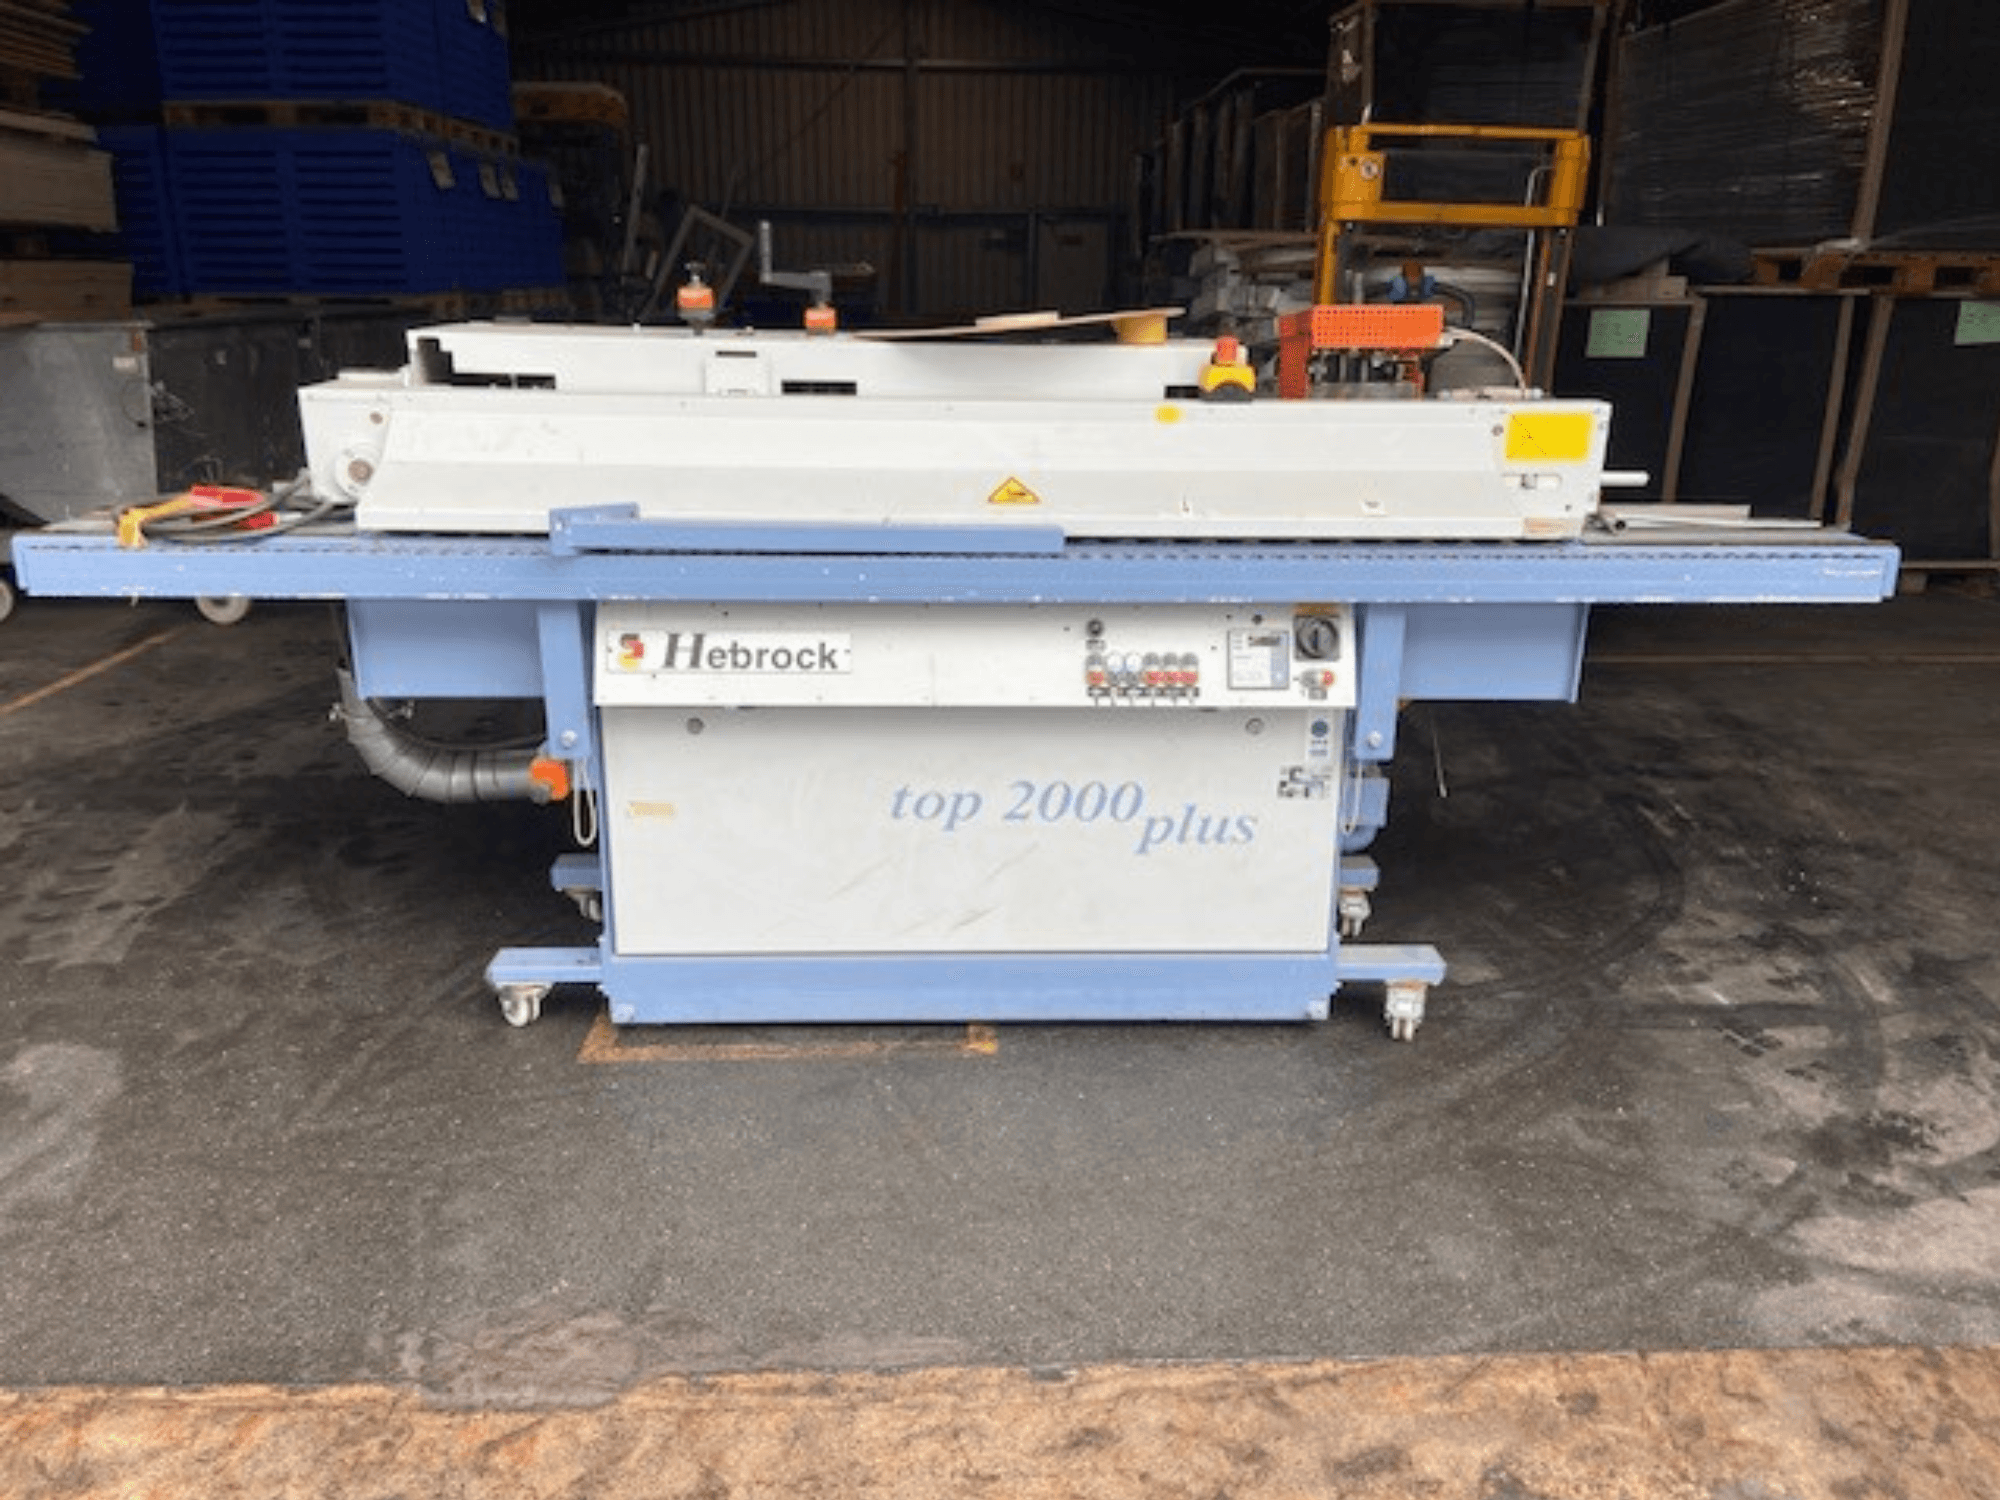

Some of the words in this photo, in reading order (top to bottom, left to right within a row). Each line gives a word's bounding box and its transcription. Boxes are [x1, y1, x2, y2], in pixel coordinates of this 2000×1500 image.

[662, 633, 838, 670] Hebrock
[890, 782, 983, 832] top
[1002, 780, 1144, 822] 2000
[1133, 803, 1259, 855] plus
